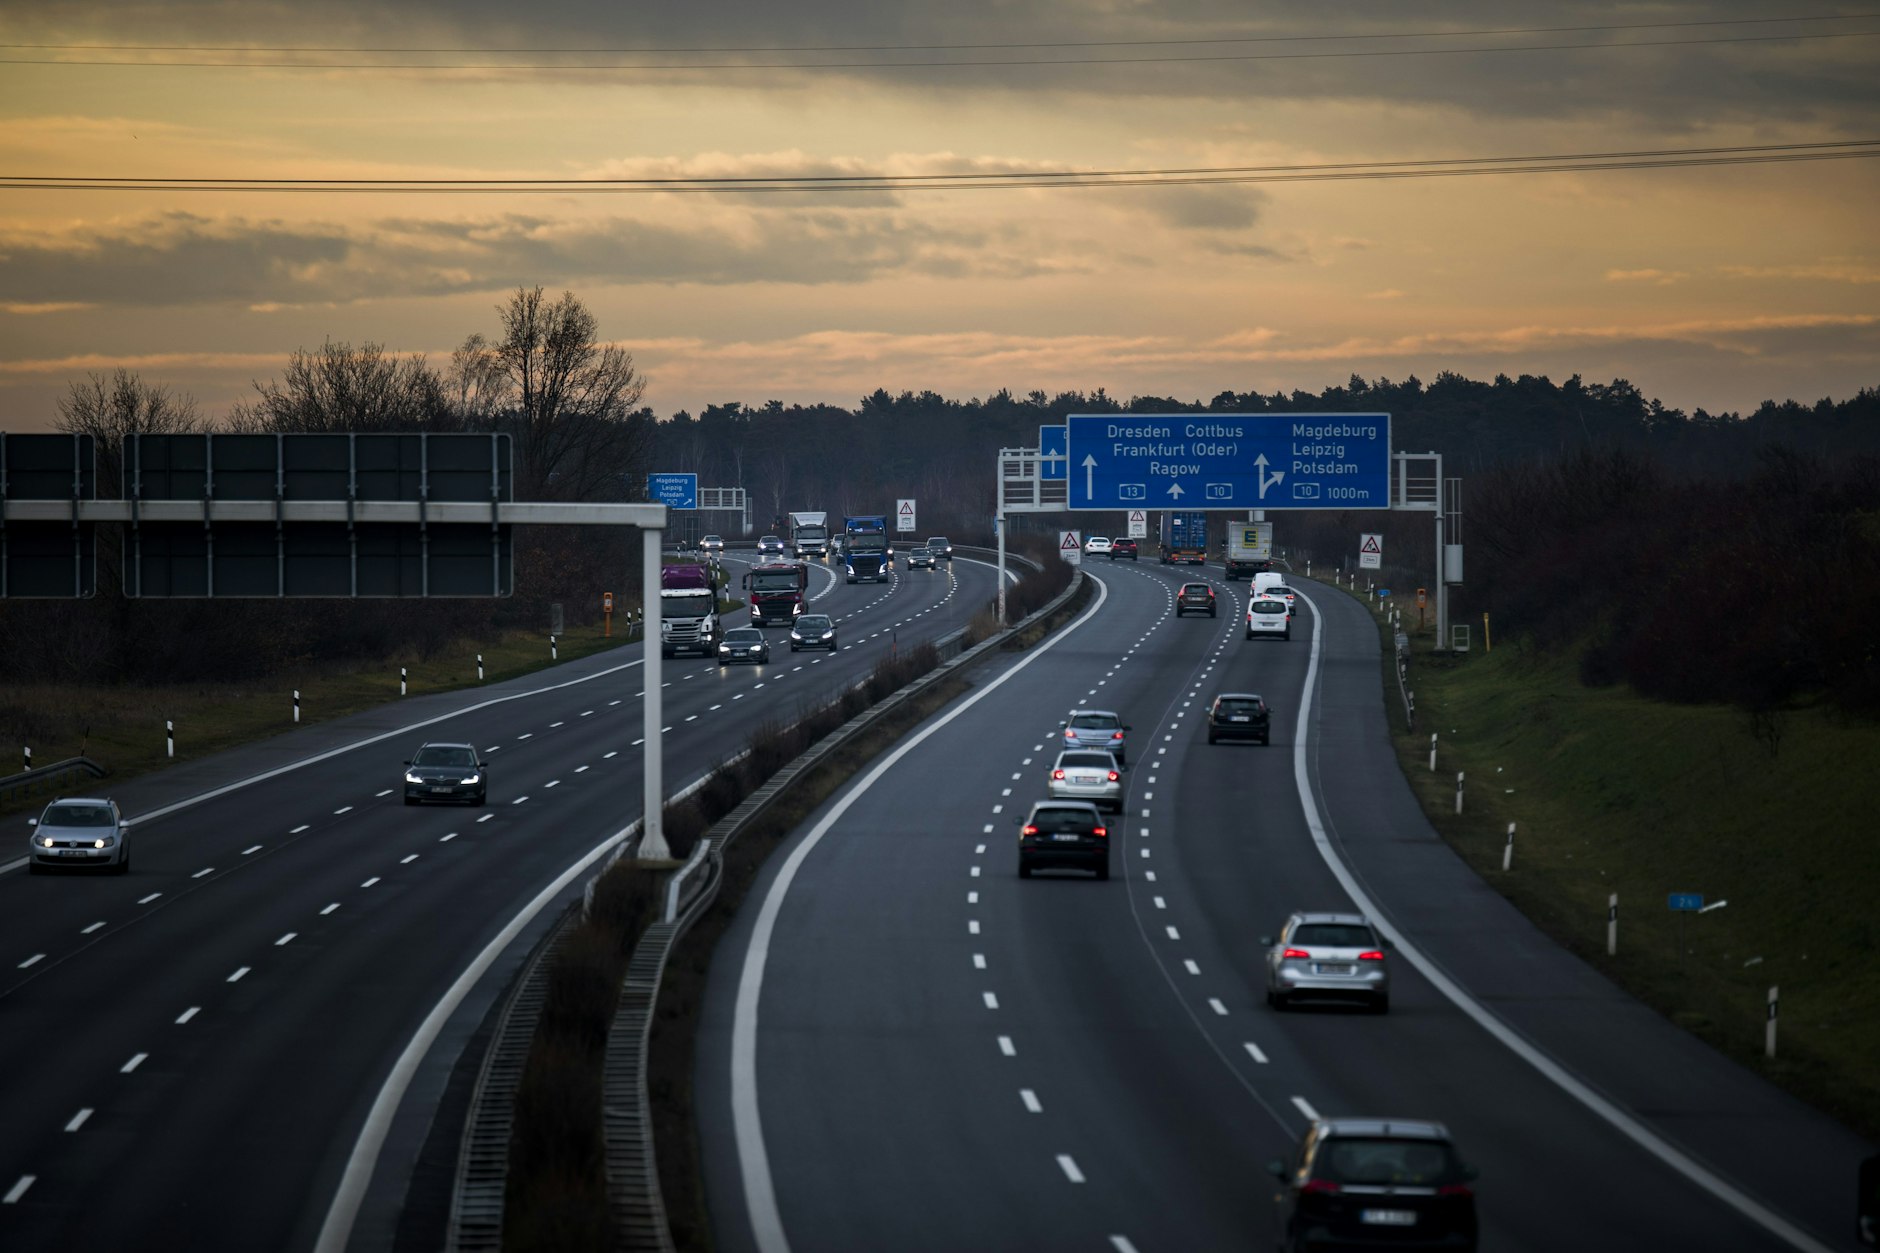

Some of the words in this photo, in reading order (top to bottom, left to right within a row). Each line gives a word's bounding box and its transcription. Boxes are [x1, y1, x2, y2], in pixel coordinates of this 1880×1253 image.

[1107, 424, 1170, 438] Dresden
[1185, 424, 1243, 438] Cottbus
[1292, 424, 1377, 440] Magdeburg
[1113, 443, 1185, 456] Frankfurt
[1191, 442, 1238, 457] (Oder)
[1292, 442, 1345, 458] Leipzig
[1150, 461, 1200, 478] Ragow
[1292, 461, 1358, 474] Potsdam
[1126, 487, 1138, 497] 13
[1213, 487, 1225, 497] 10
[1301, 486, 1312, 496] 10
[1327, 487, 1369, 499] 1000m
[1244, 530, 1257, 543] E
